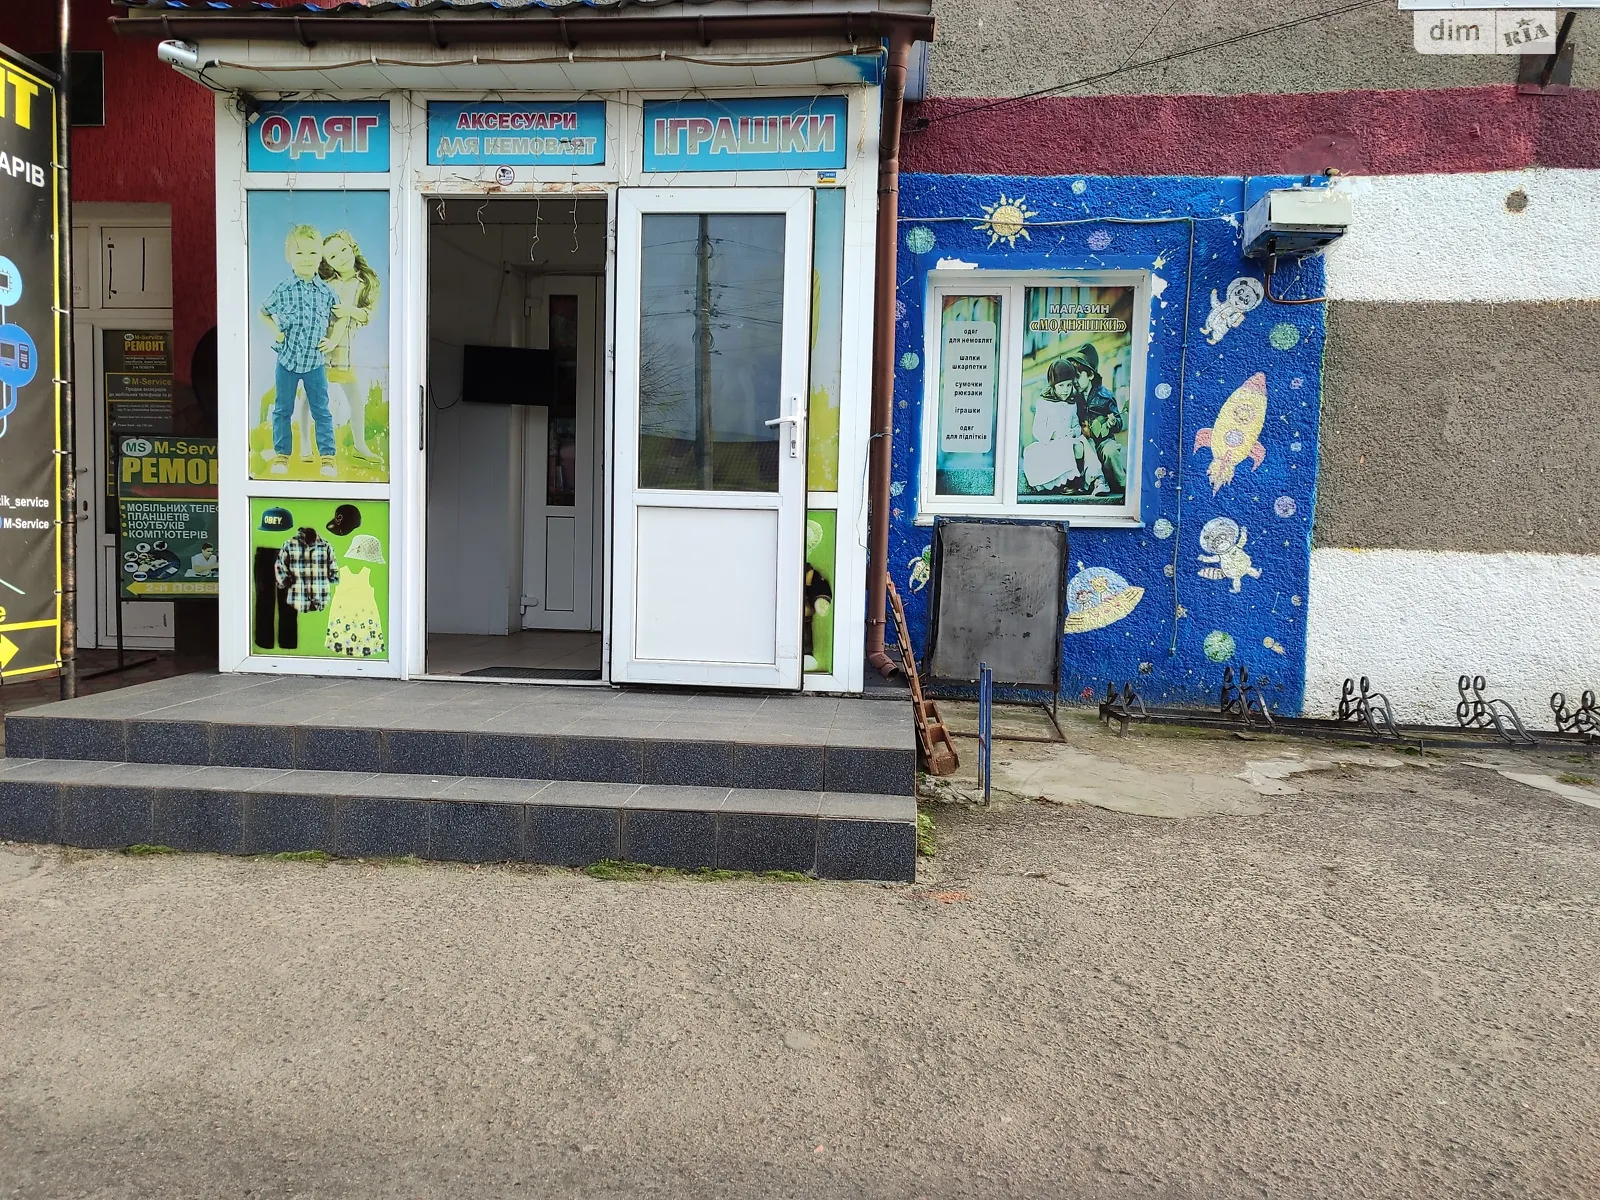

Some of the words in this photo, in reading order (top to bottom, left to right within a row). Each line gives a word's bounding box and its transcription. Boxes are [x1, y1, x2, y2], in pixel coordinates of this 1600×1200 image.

[456, 112, 578, 130] АКСЕСУАРИ
[260, 115, 378, 159] ОДЯГ
[654, 115, 835, 155] ІГРАШКИ
[437, 137, 480, 157] ДЛЯ
[1050, 304, 1110, 314] МАГАЗИН
[124, 341, 165, 351] РЕМОНТ
[131, 378, 172, 386] M-Service
[126, 442, 146, 452] MS
[127, 503, 188, 513] МОБІЛЬНИХ
[127, 512, 190, 521] ПЛАНШЕТІВ
[264, 516, 282, 524] OBEY
[3, 517, 49, 530] M-Service
[128, 521, 185, 530] НОУТБУКІВ
[128, 530, 209, 539] КОМП'ЮТЕРІВ
